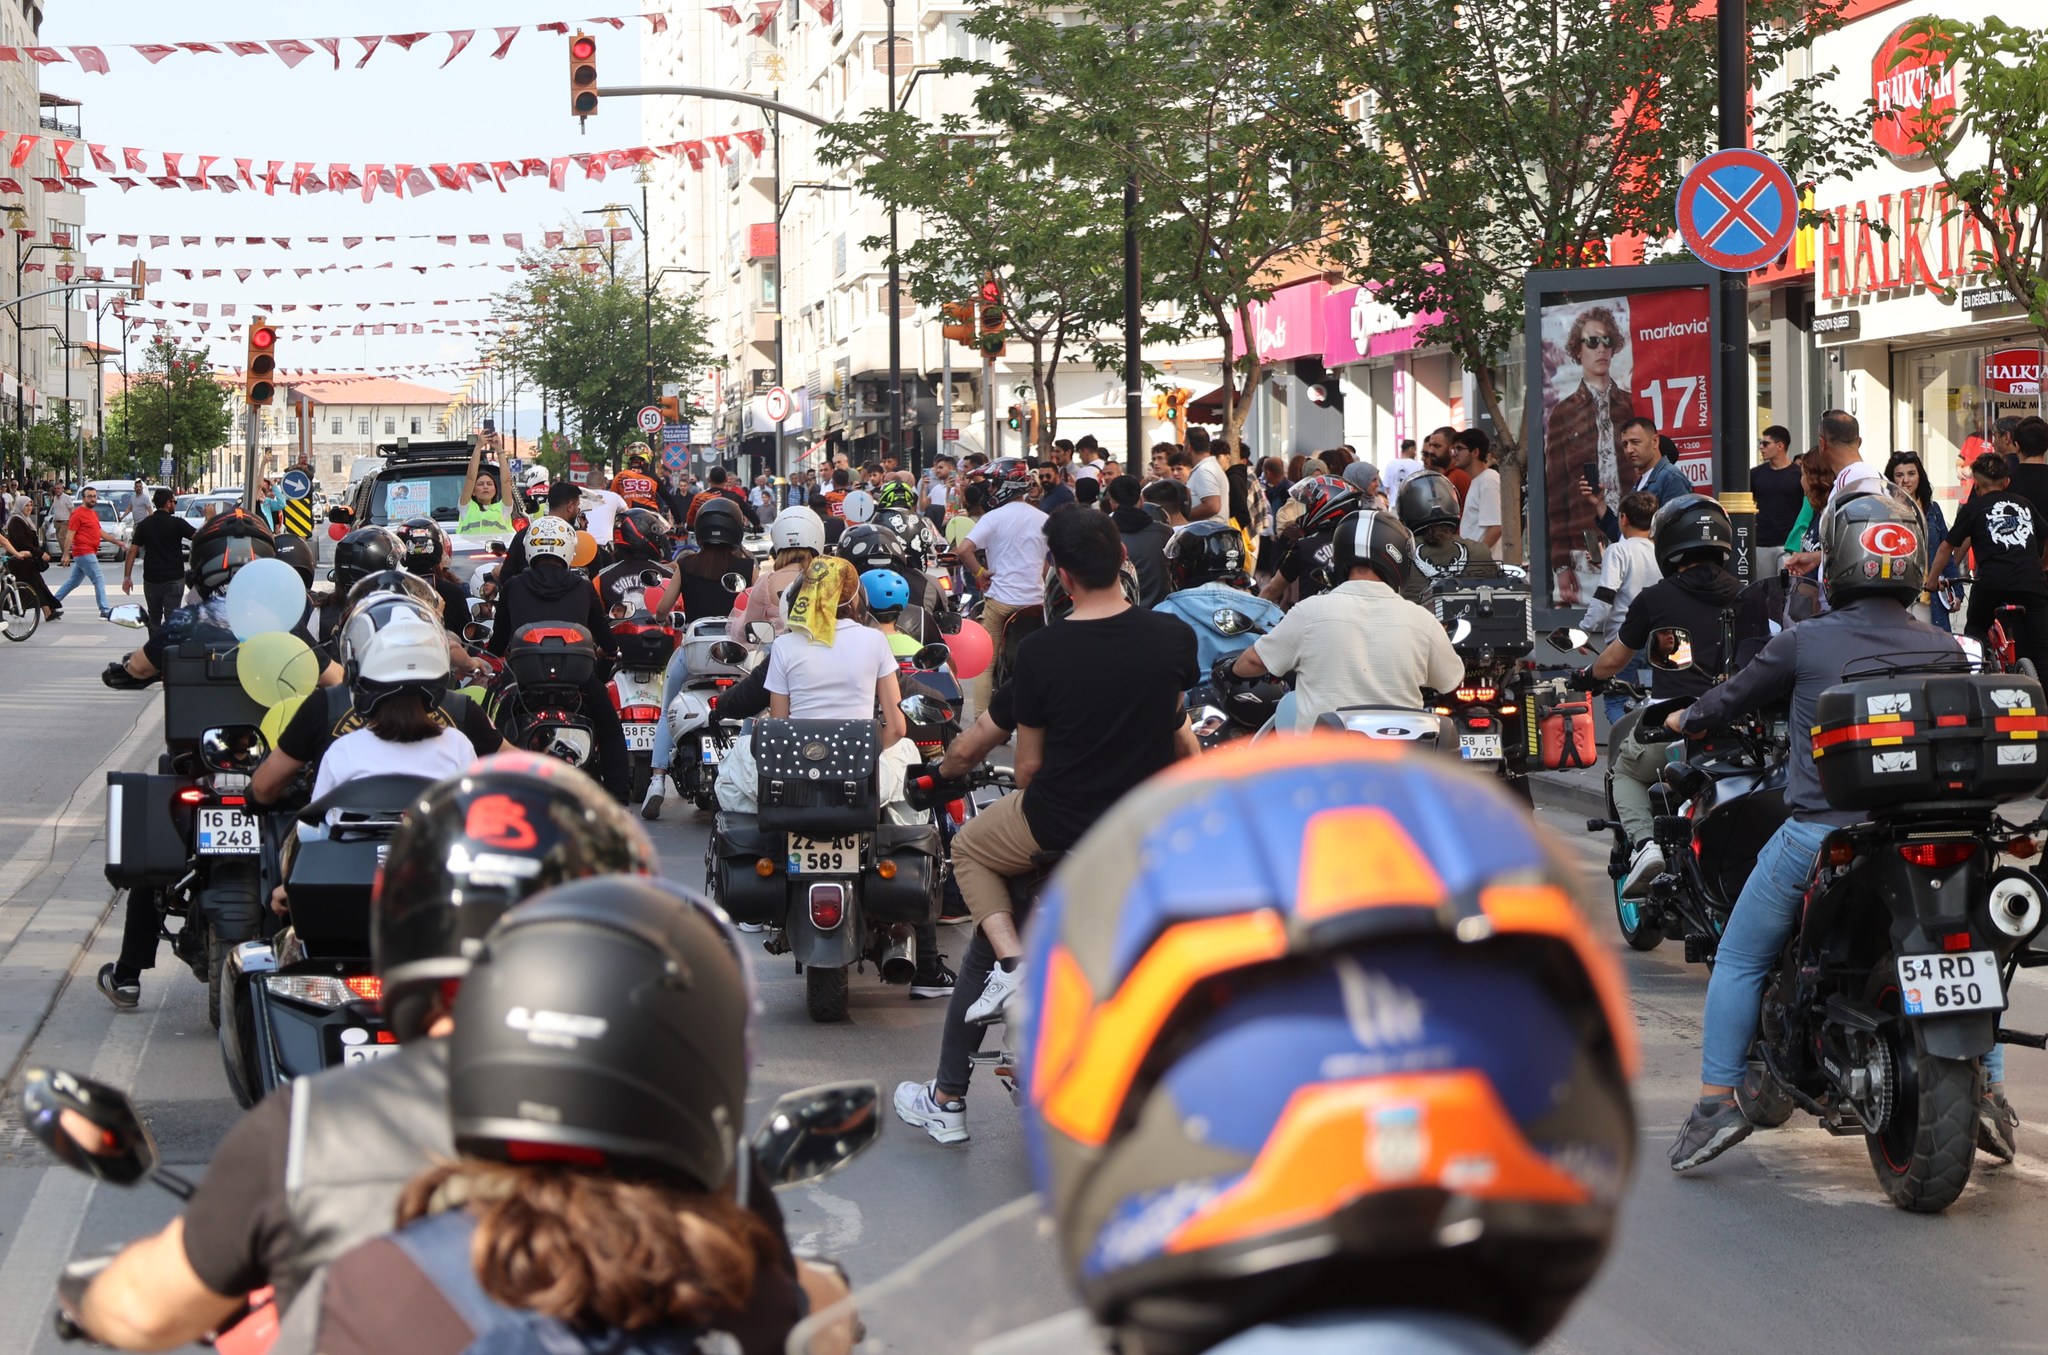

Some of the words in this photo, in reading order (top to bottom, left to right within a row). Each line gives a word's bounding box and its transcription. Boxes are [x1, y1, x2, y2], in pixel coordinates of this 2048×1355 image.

[1639, 318, 1708, 341] markavia
[1640, 376, 1698, 431] 17
[1698, 375, 1708, 427] HAZİRAN
[644, 413, 658, 425] 50
[1683, 442, 1701, 450] 13:00
[623, 479, 651, 493] 58
[625, 727, 638, 736] 58
[1461, 737, 1475, 746] 58
[1485, 736, 1498, 745] FY
[1472, 747, 1492, 757] 745
[204, 812, 223, 827] 16
[231, 812, 255, 827] BA
[216, 830, 252, 846] 248
[807, 852, 843, 870] 589
[1903, 959, 1933, 981] 54
[1939, 956, 1975, 979] RD
[1935, 983, 1982, 1007] 650
[1909, 1005, 1921, 1014] TR
